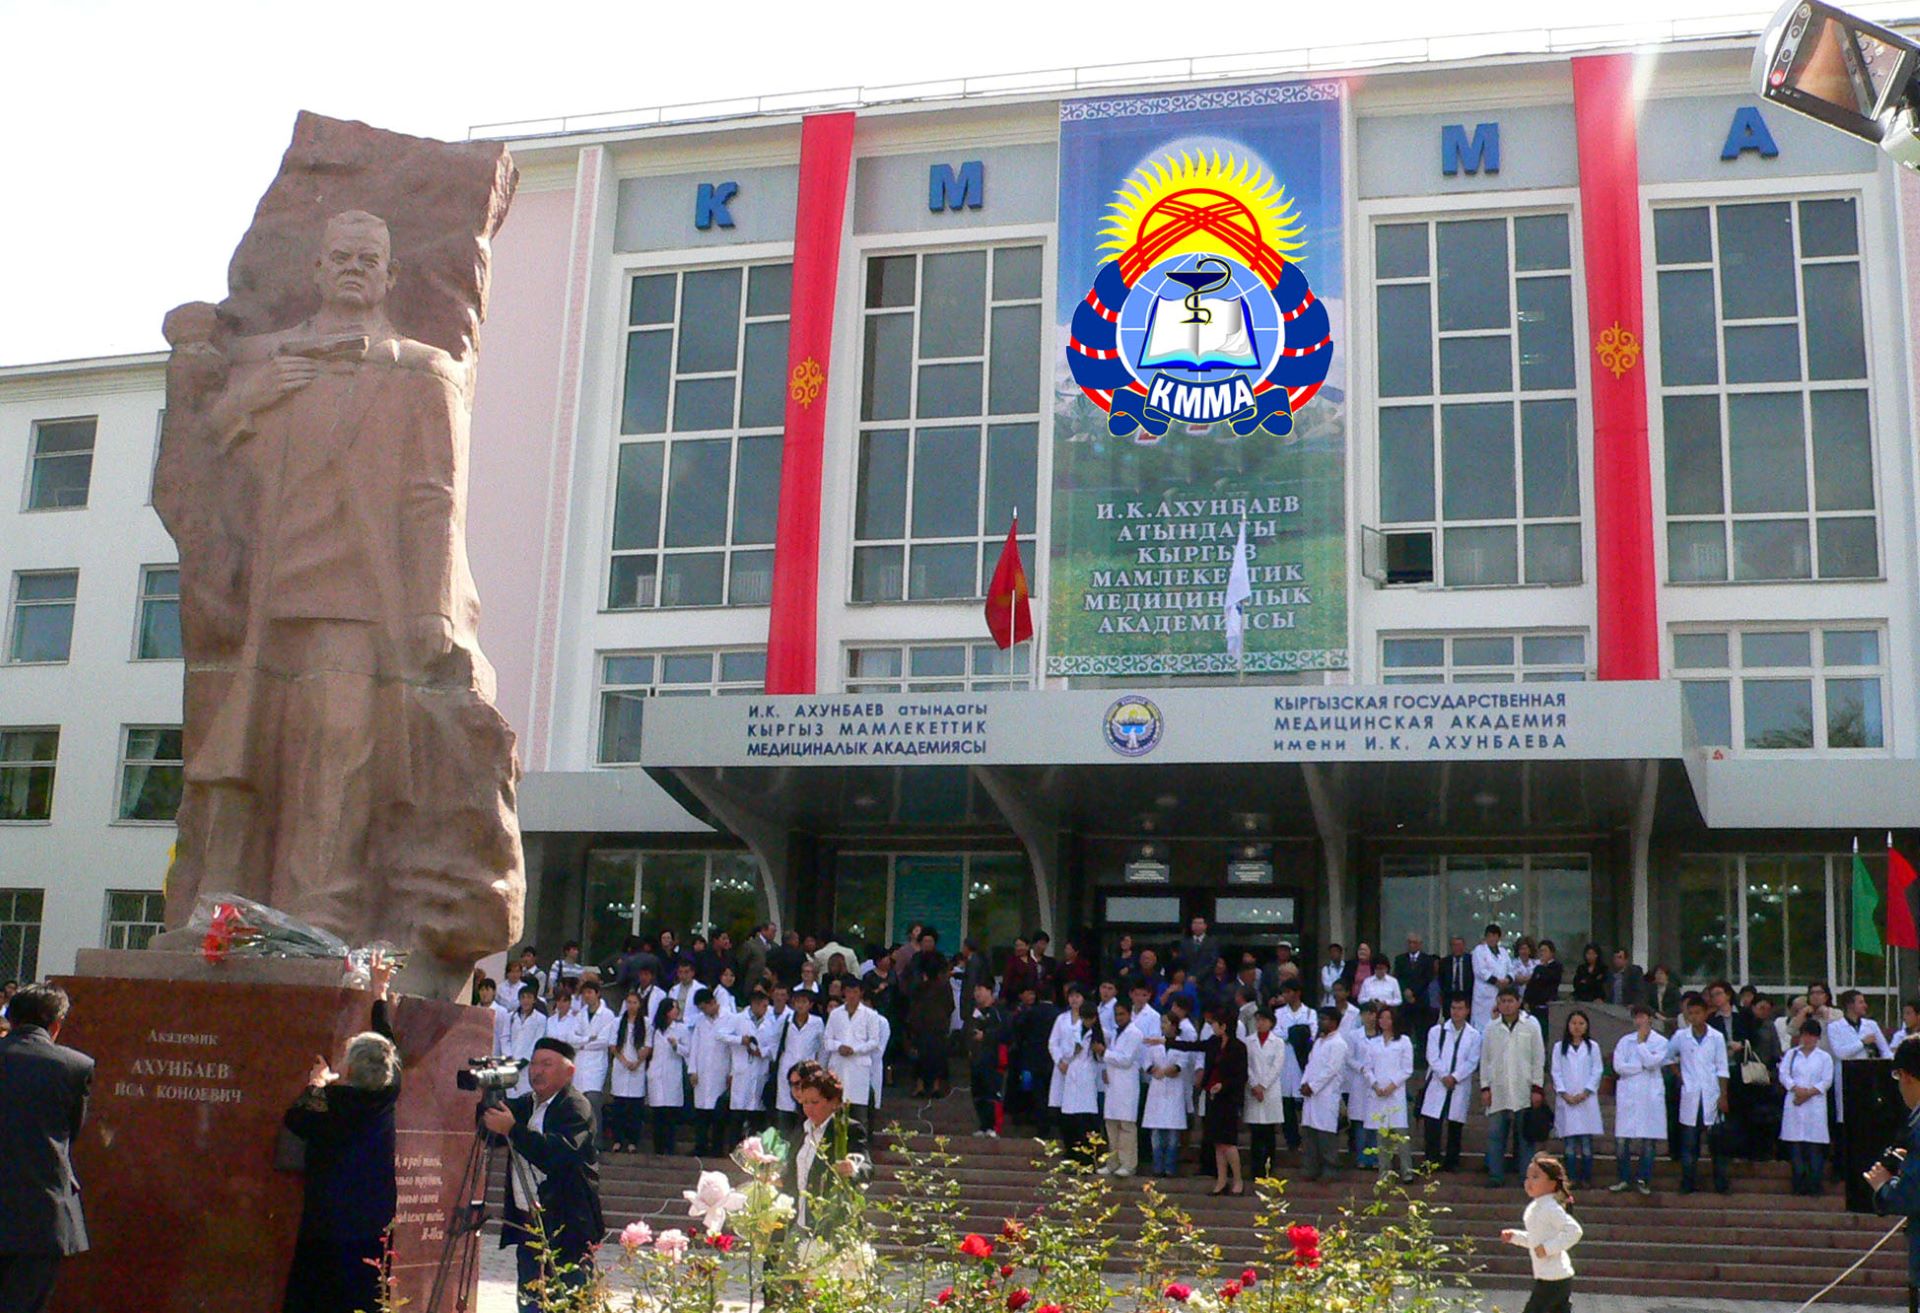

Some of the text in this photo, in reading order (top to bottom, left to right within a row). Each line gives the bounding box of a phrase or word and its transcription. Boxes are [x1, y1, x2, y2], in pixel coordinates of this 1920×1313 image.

[694, 106, 1779, 230] К М М А
[1137, 543, 1257, 564] КЫРГЫЗ
[1092, 563, 1304, 588] МАМЛЕКЕТИК
[1083, 586, 1311, 613] МЕДИЦИНЛЫК
[748, 703, 987, 718] И.К. АХУНБАЕВ атындагы
[1274, 693, 1567, 711] КЫРГЫЗСКАЯ ГОСУДАРСТВЕННАЯ
[747, 720, 987, 738] КЫРГЫЗ МАМЛЕКЕТТИК
[1274, 713, 1567, 731] МЕДИЦИНСКАЯ АКАДЕМИЯ
[747, 740, 987, 758] МЕДИЦИНАЛЫК АКАДЕМИЯСЫ
[1273, 734, 1567, 751] имени И.К. АХУНБАЕВА
[148, 1029, 219, 1046] Академик
[131, 1058, 231, 1079] АХУНБАЕВ
[156, 1084, 242, 1103] КОНОЕВИЧ
